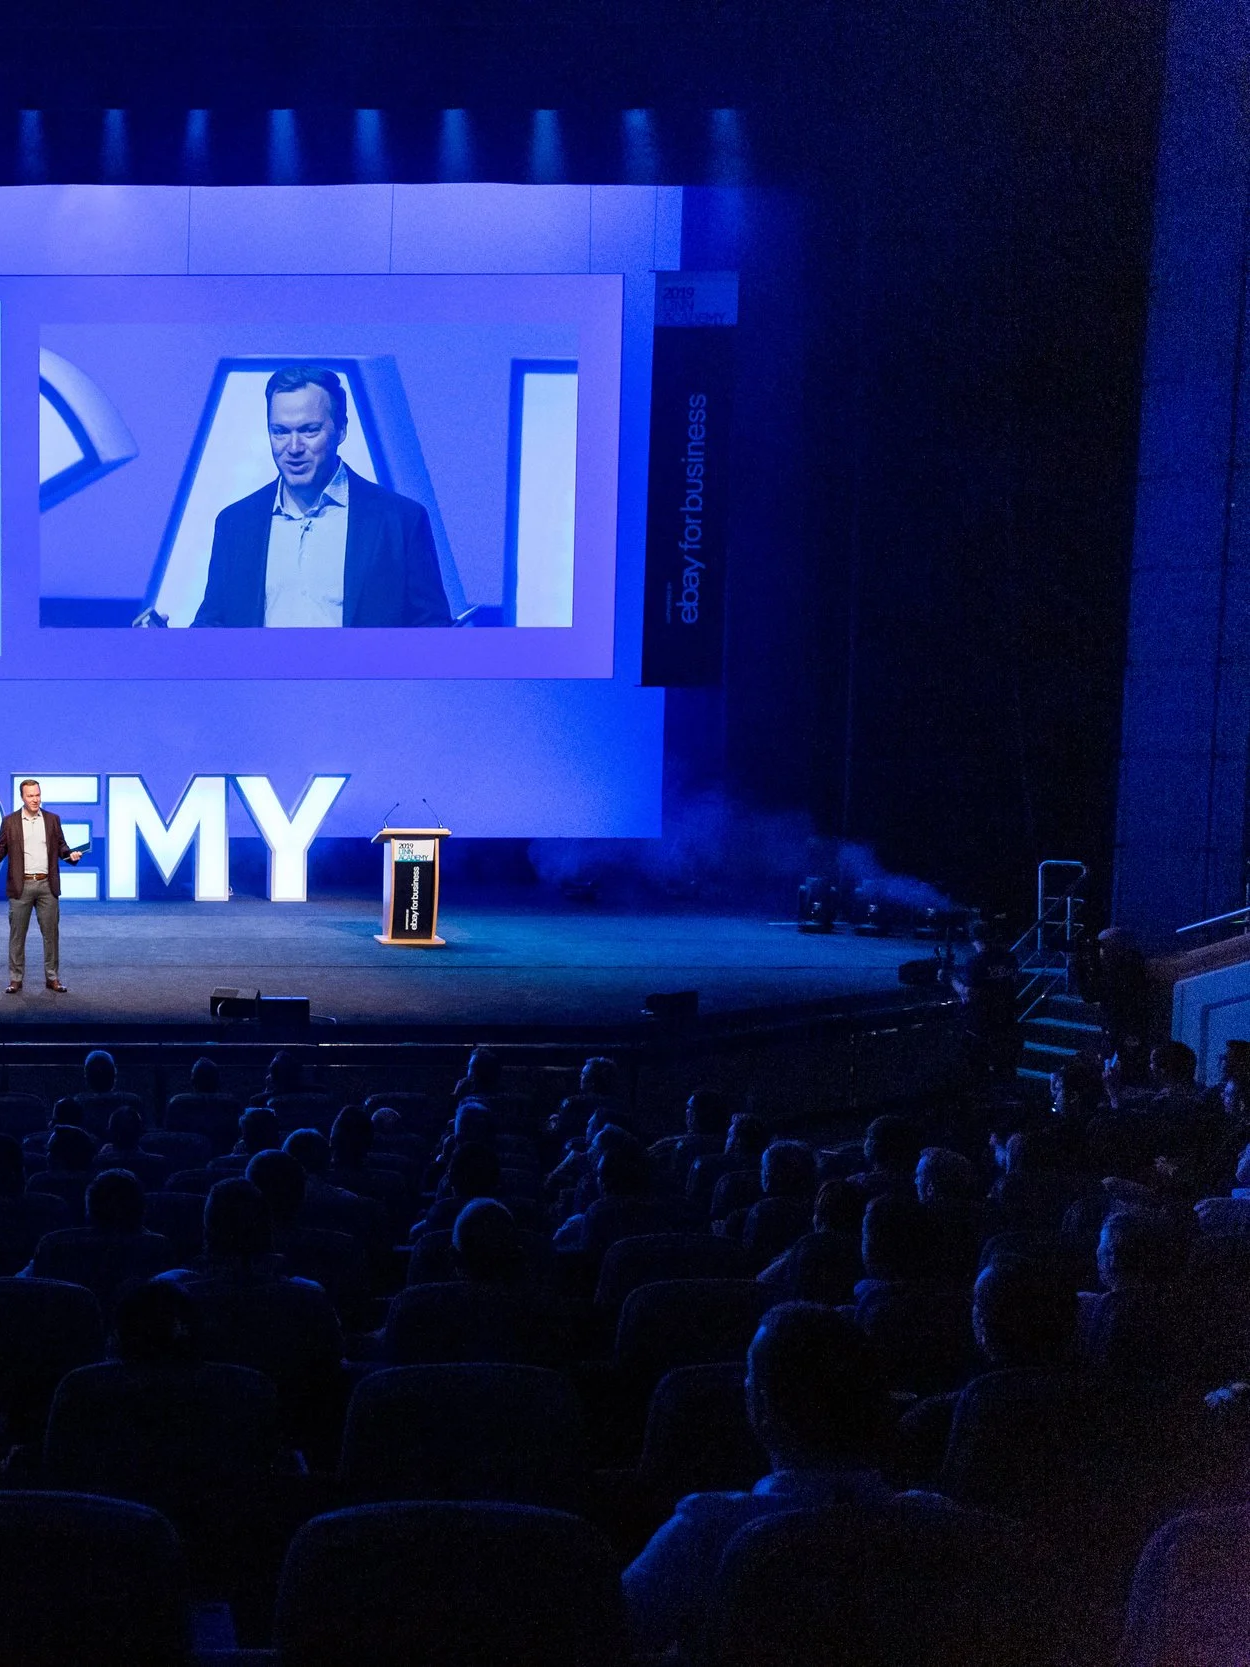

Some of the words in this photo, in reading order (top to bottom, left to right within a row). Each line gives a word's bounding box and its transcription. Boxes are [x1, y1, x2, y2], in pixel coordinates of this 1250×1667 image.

[662, 286, 695, 299] 2019
[680, 393, 707, 512] business
[678, 514, 703, 552] for
[675, 553, 706, 624] ebay
[410, 866, 420, 900] business
[410, 899, 419, 910] for
[410, 910, 420, 931] ebay
